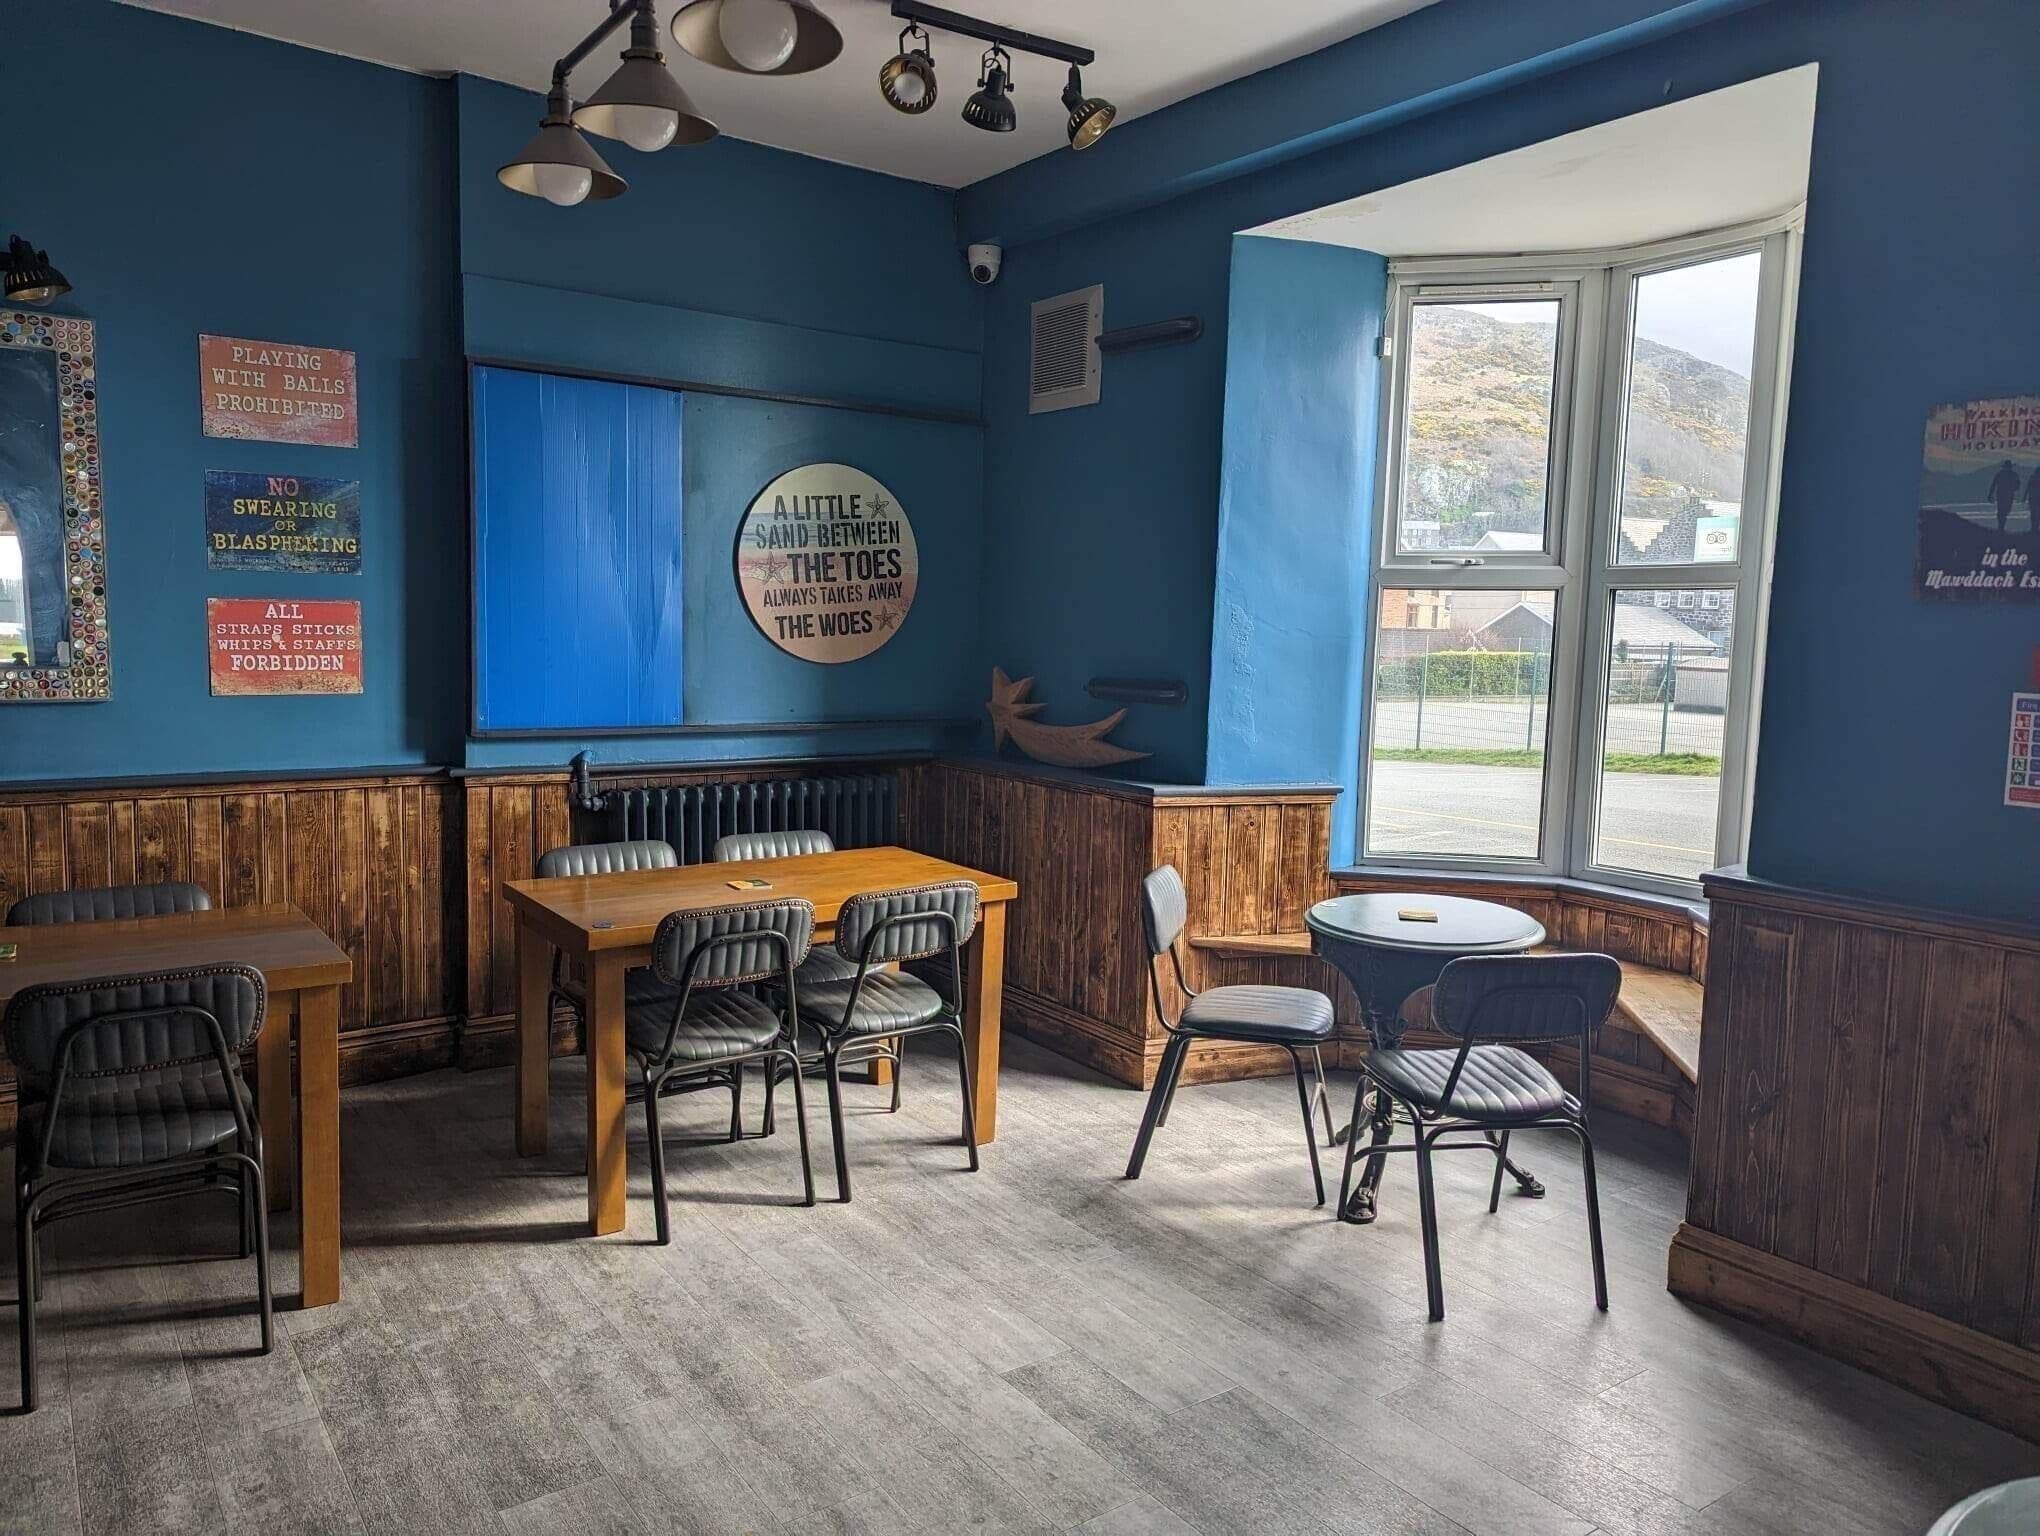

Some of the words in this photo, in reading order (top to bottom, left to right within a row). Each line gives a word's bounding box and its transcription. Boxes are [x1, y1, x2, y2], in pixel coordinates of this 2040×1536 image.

[232, 346, 322, 371] PLAYING
[212, 368, 266, 388] WITH
[283, 374, 345, 395] BALLS
[215, 393, 344, 420] PROHIBITED
[267, 477, 299, 496] NO
[233, 499, 337, 518] SWEARING
[774, 495, 788, 520] A
[792, 494, 862, 520] LITTLE
[274, 520, 297, 531] OR
[756, 523, 809, 550] SAND
[817, 520, 901, 548] BETWEEN
[213, 533, 357, 553] BLASPHEMING
[787, 552, 837, 584] THE
[840, 549, 902, 581] TOES
[1982, 547, 1999, 568] in
[2001, 548, 2028, 566] the
[1925, 569, 2015, 589] Mawddach
[763, 587, 817, 608] ALWAYS
[819, 584, 863, 605] TAKES
[868, 581, 903, 601] AWAY
[265, 603, 303, 619] ALL
[216, 623, 283, 635] STRAPS
[292, 624, 354, 635] STICKS
[775, 613, 815, 640] THE
[818, 610, 873, 637] WOES
[217, 639, 272, 650] WHIPS
[279, 642, 287, 650] &
[293, 640, 356, 650] STAFFS
[231, 654, 344, 671] FORBIDDEN
